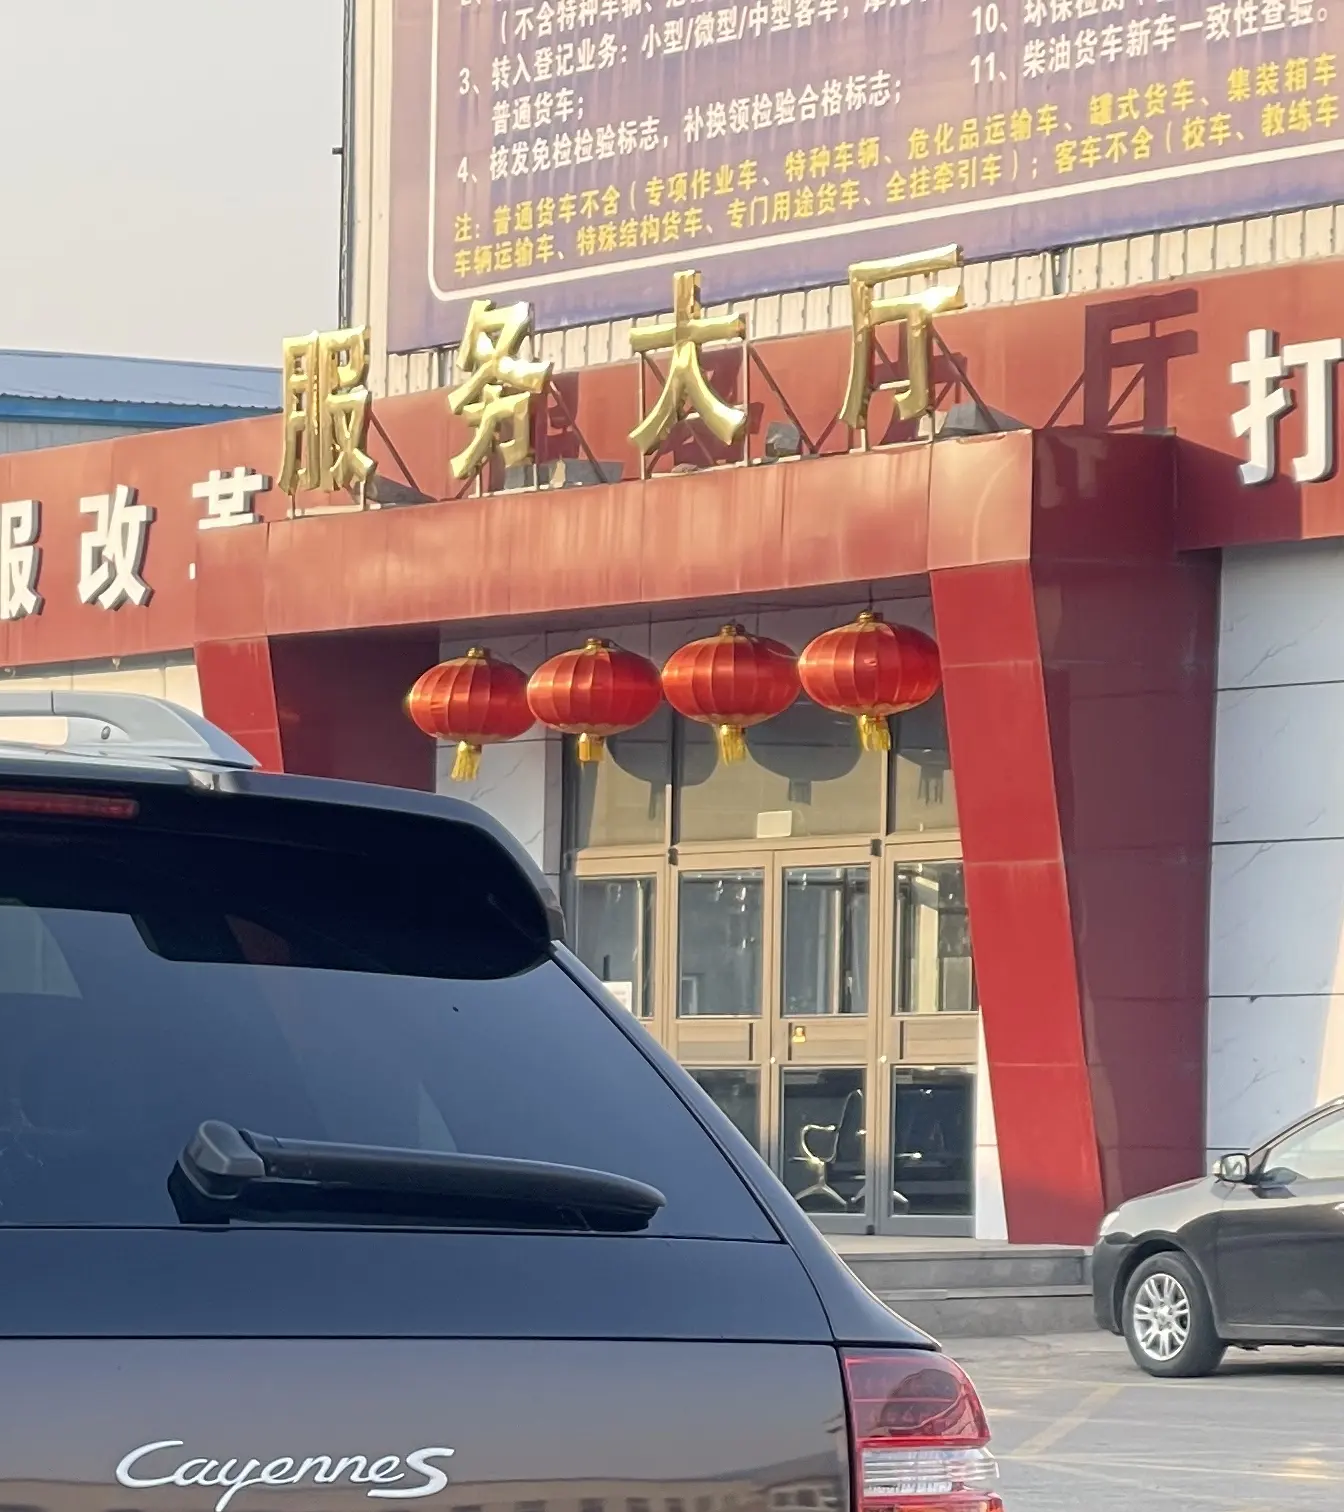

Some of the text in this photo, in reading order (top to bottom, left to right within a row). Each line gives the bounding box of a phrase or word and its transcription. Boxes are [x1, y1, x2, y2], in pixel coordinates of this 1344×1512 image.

[278, 244, 966, 494] 服务大厅
[1230, 328, 1344, 486] 打
